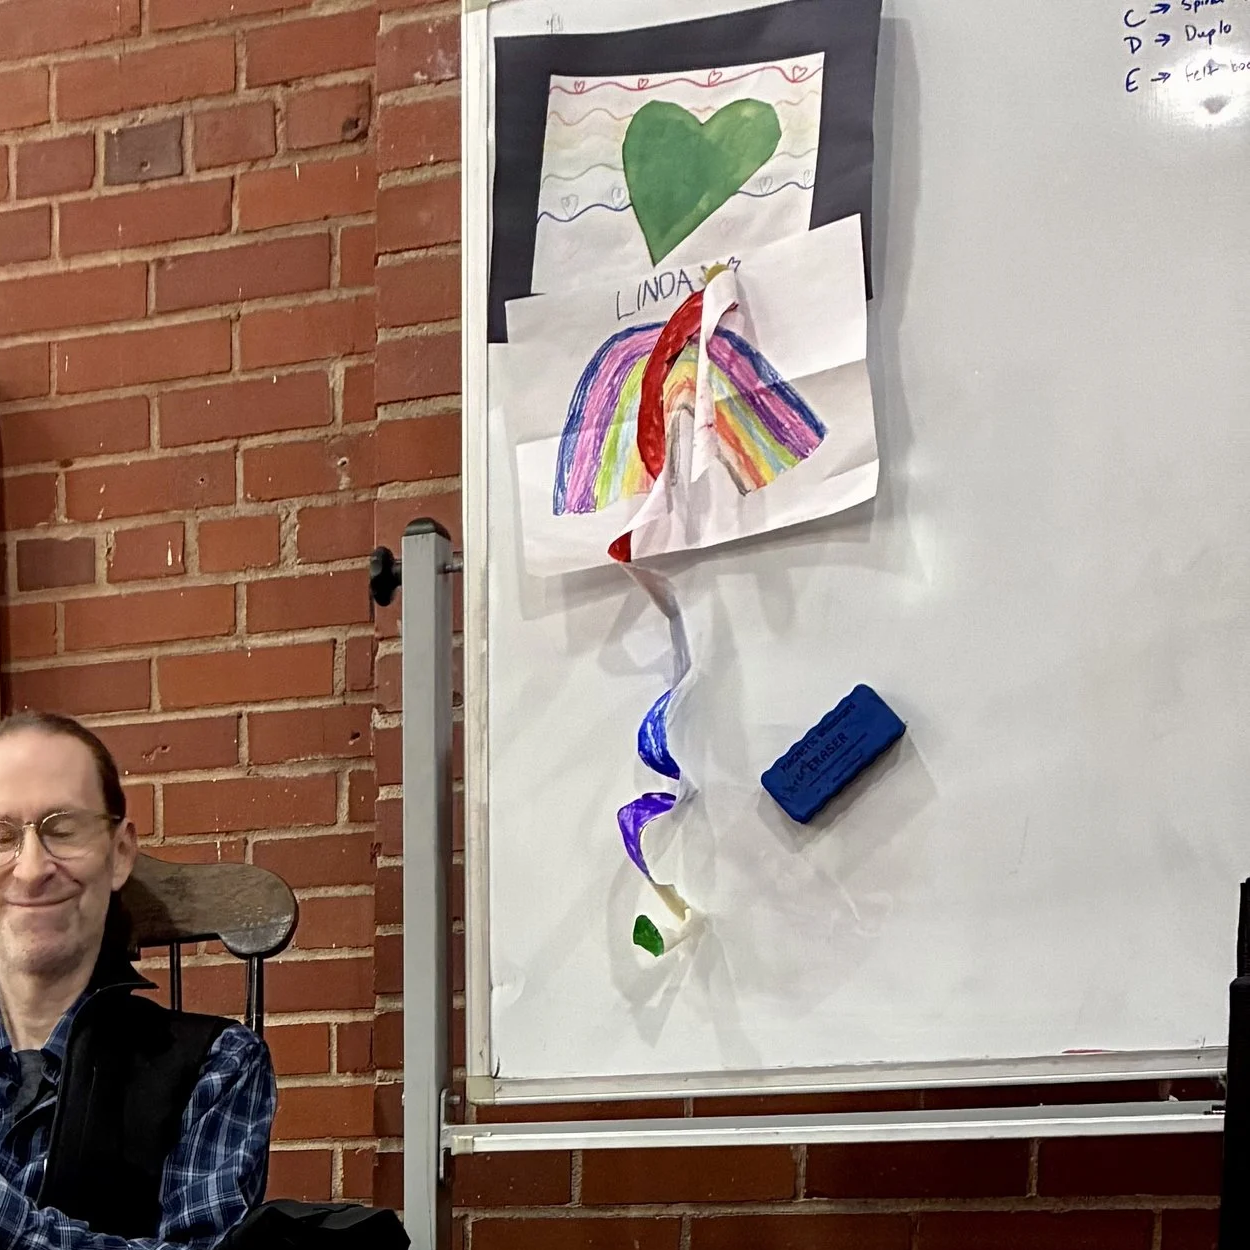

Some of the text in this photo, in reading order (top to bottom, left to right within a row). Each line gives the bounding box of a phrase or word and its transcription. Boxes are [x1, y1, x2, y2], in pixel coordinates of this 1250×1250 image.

[1124, 9, 1146, 28] C
[1123, 20, 1232, 54] D Duplo
[1126, 67, 1141, 92] E
[616, 268, 694, 320] LINDA
[807, 732, 849, 771] ERASER
